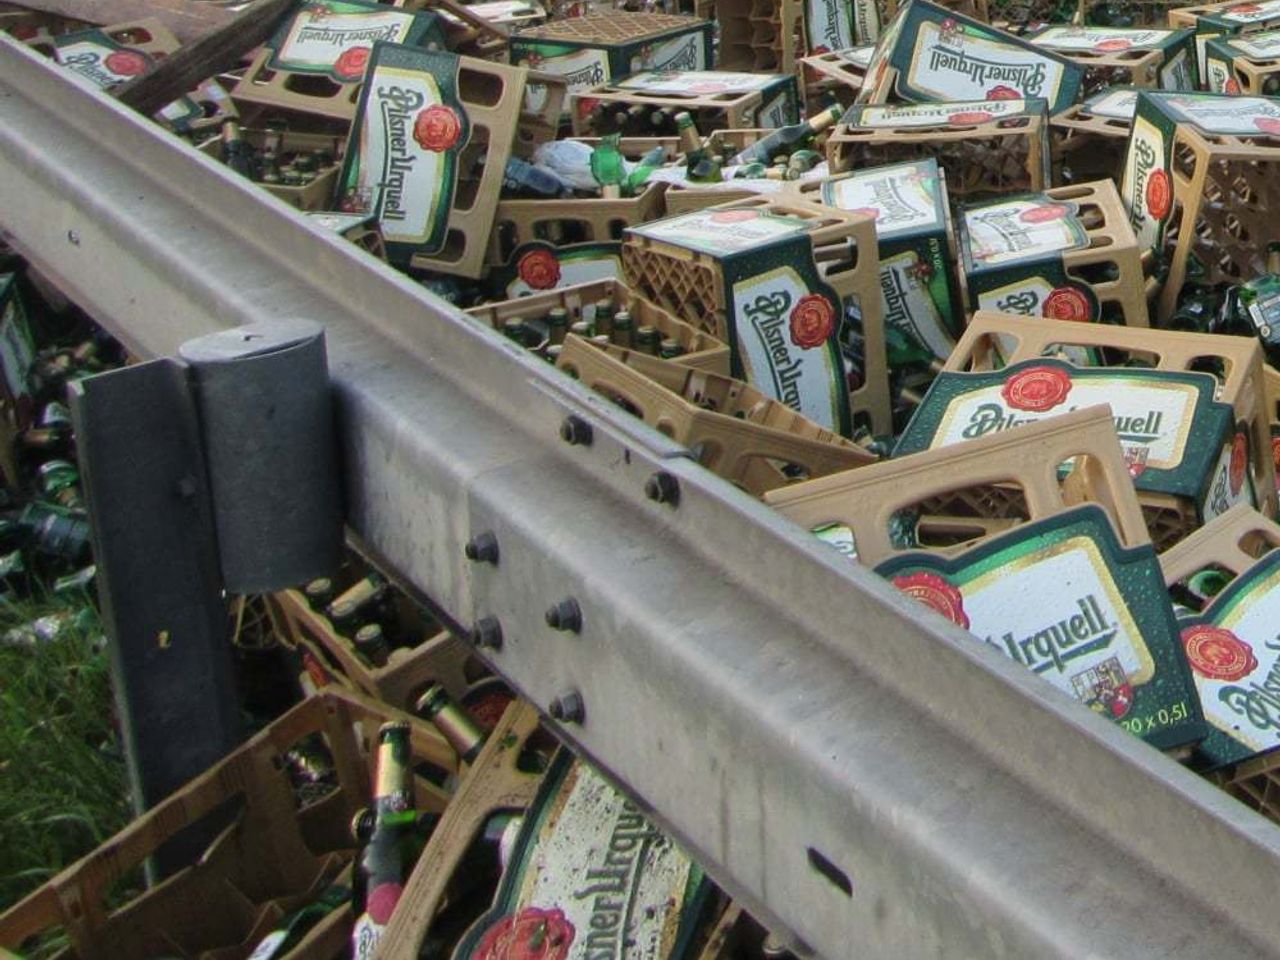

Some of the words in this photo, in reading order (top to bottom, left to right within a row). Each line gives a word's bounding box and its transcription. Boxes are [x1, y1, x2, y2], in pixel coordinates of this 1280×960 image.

[930, 50, 985, 87] Urquell
[985, 62, 1047, 97] Pilsner
[378, 86, 424, 155] Pilsner
[377, 155, 417, 221] Urquell
[1134, 137, 1156, 217] Pilsner
[743, 290, 792, 366] Pilsner
[1145, 717, 1155, 728] x
[572, 800, 666, 900] Urqu
